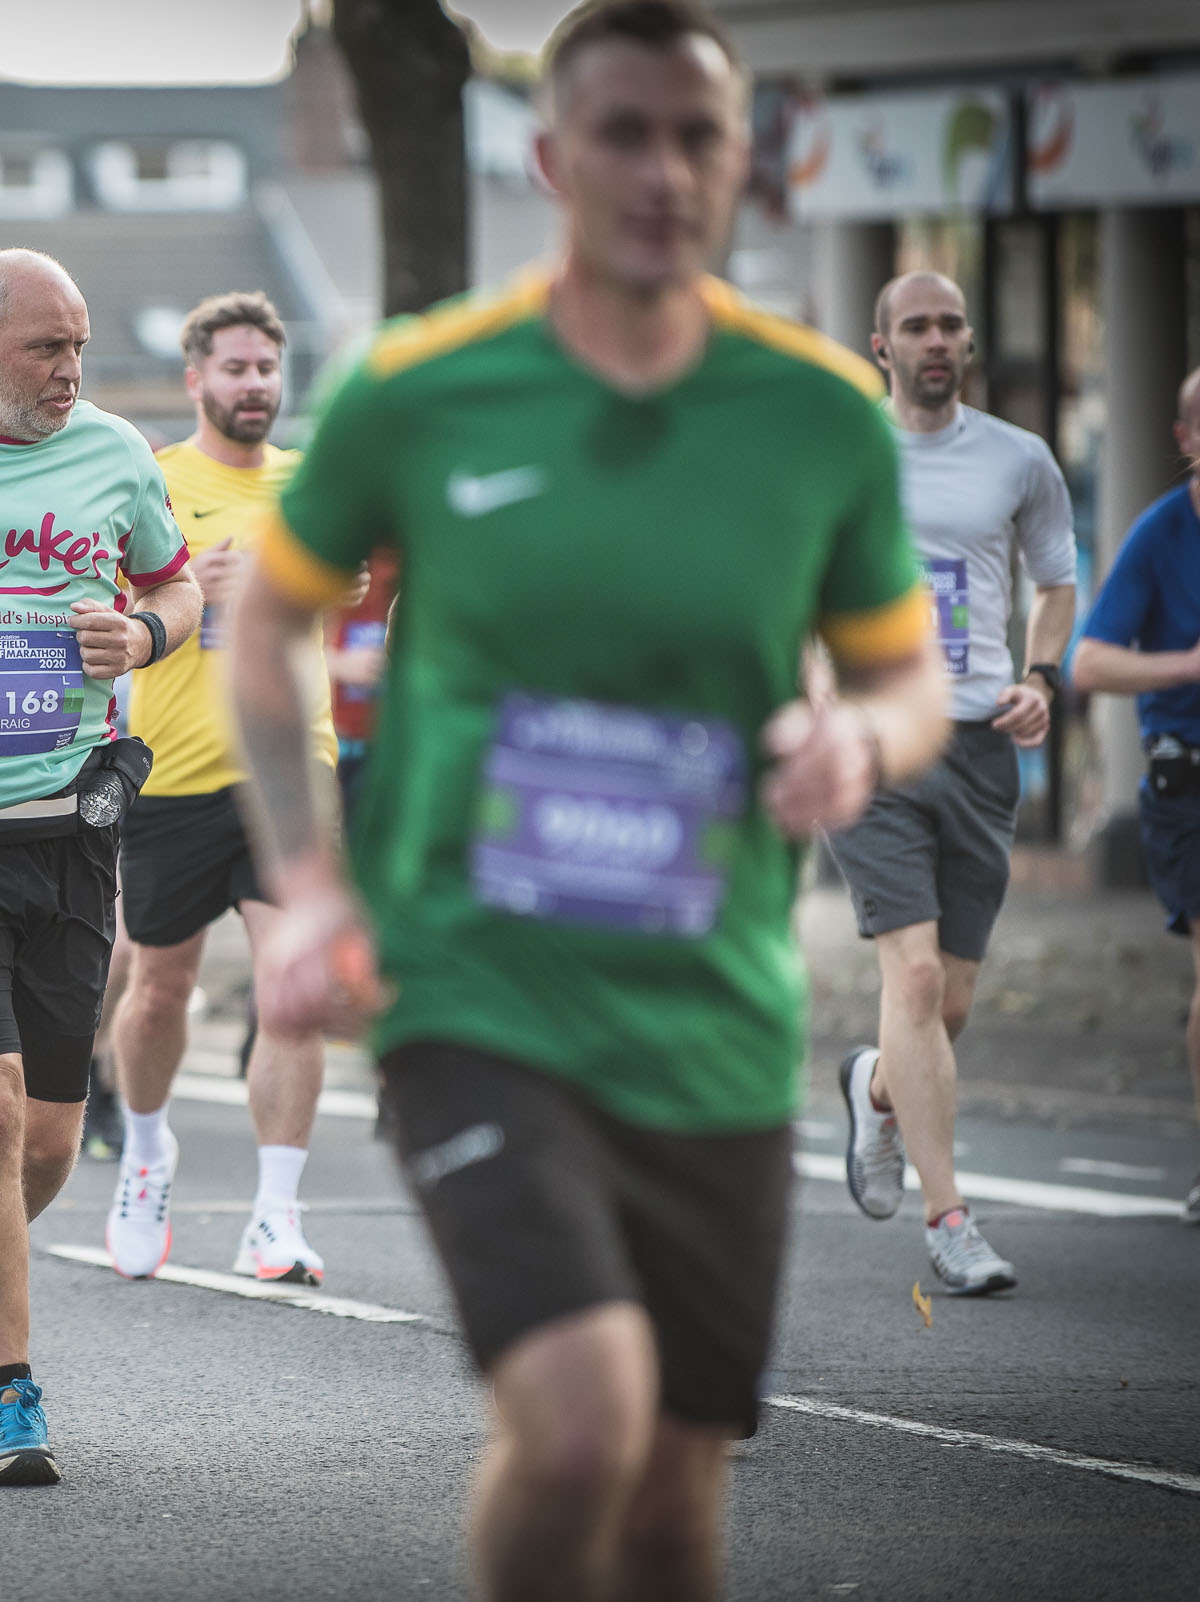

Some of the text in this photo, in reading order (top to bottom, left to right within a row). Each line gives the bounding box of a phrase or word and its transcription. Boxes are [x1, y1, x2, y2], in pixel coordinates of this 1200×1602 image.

[27, 611, 71, 627] Hospi
[6, 649, 65, 659] MARATHON
[39, 660, 66, 669] 2020
[62, 675, 70, 685] L
